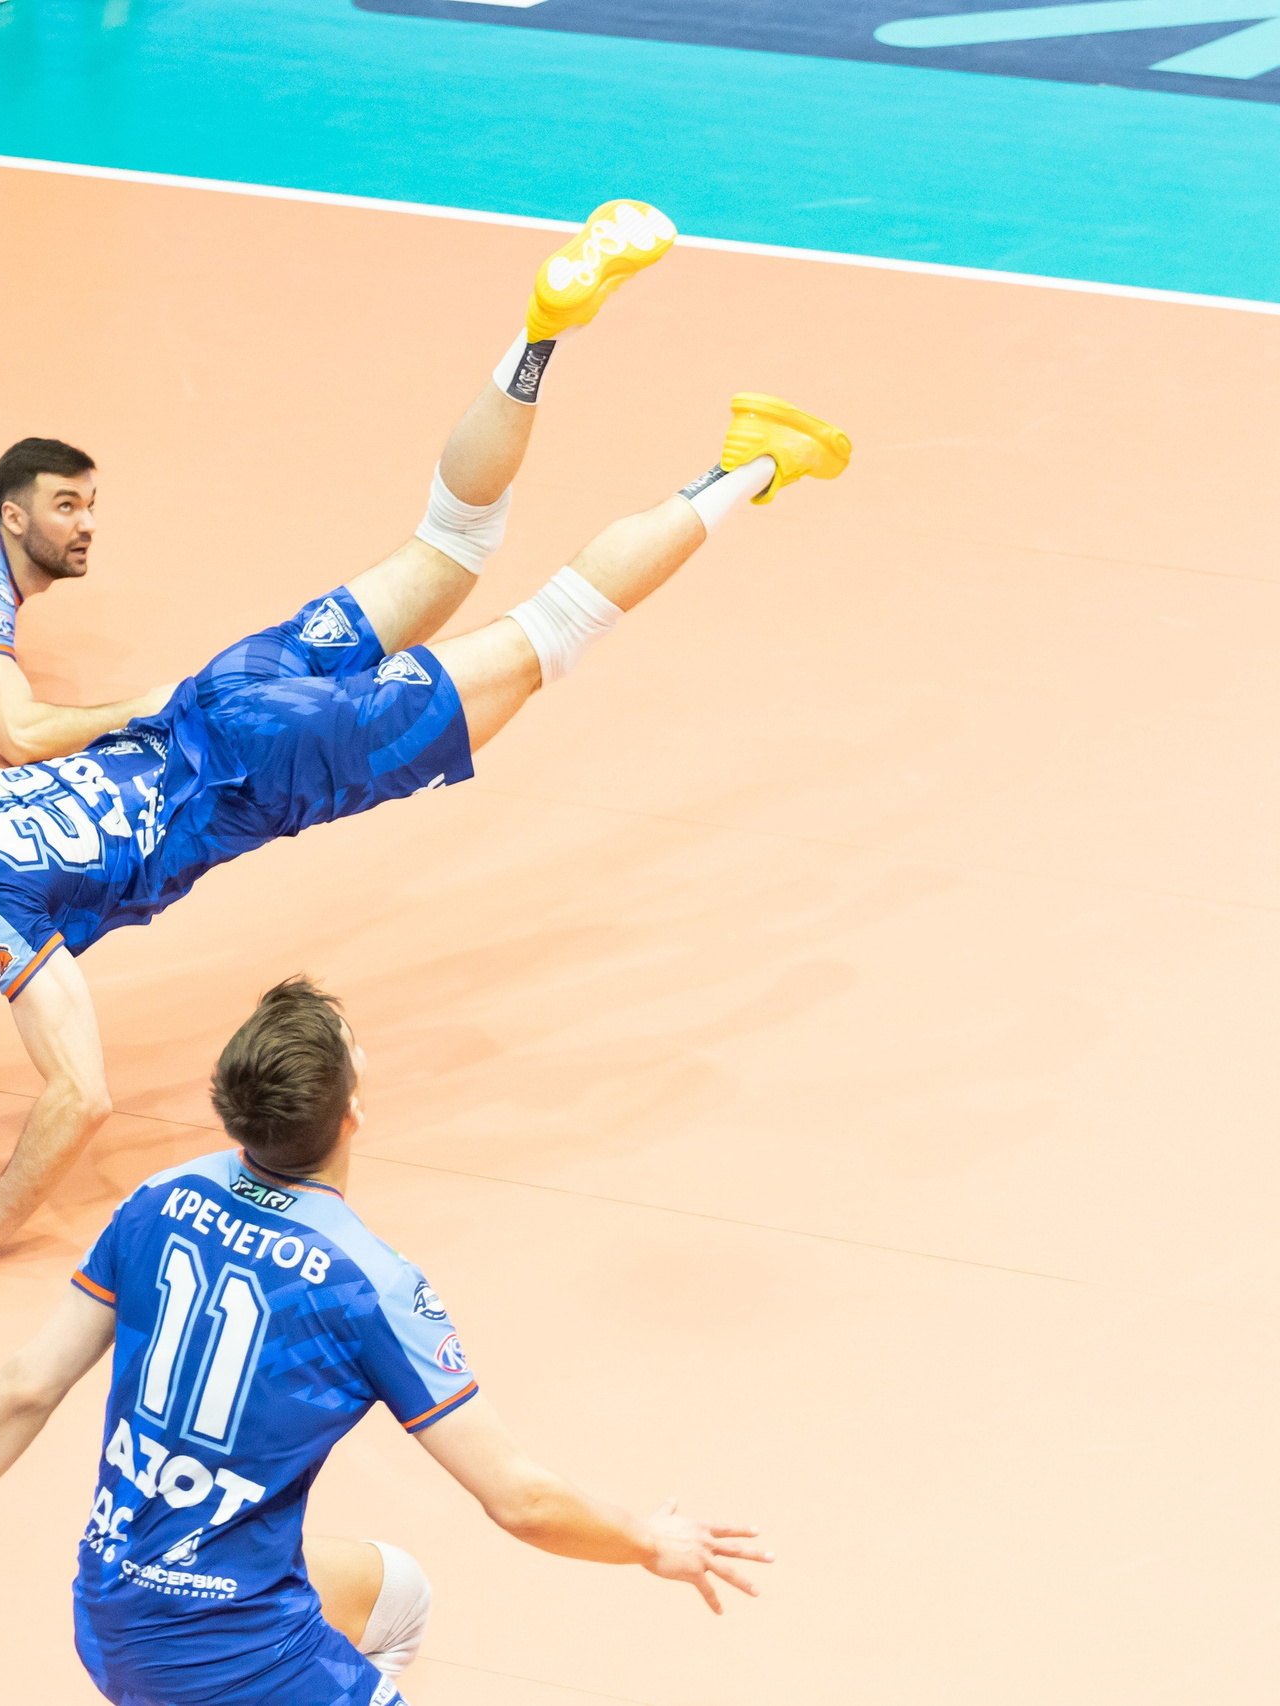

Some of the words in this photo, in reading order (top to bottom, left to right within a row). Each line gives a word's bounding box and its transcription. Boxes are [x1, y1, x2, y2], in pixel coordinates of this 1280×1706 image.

[161, 1186, 333, 1286] КРЕЧЕТОВ
[231, 1175, 294, 1211] PARI
[134, 1233, 272, 1455] 11
[105, 1418, 266, 1526] АЗОТ
